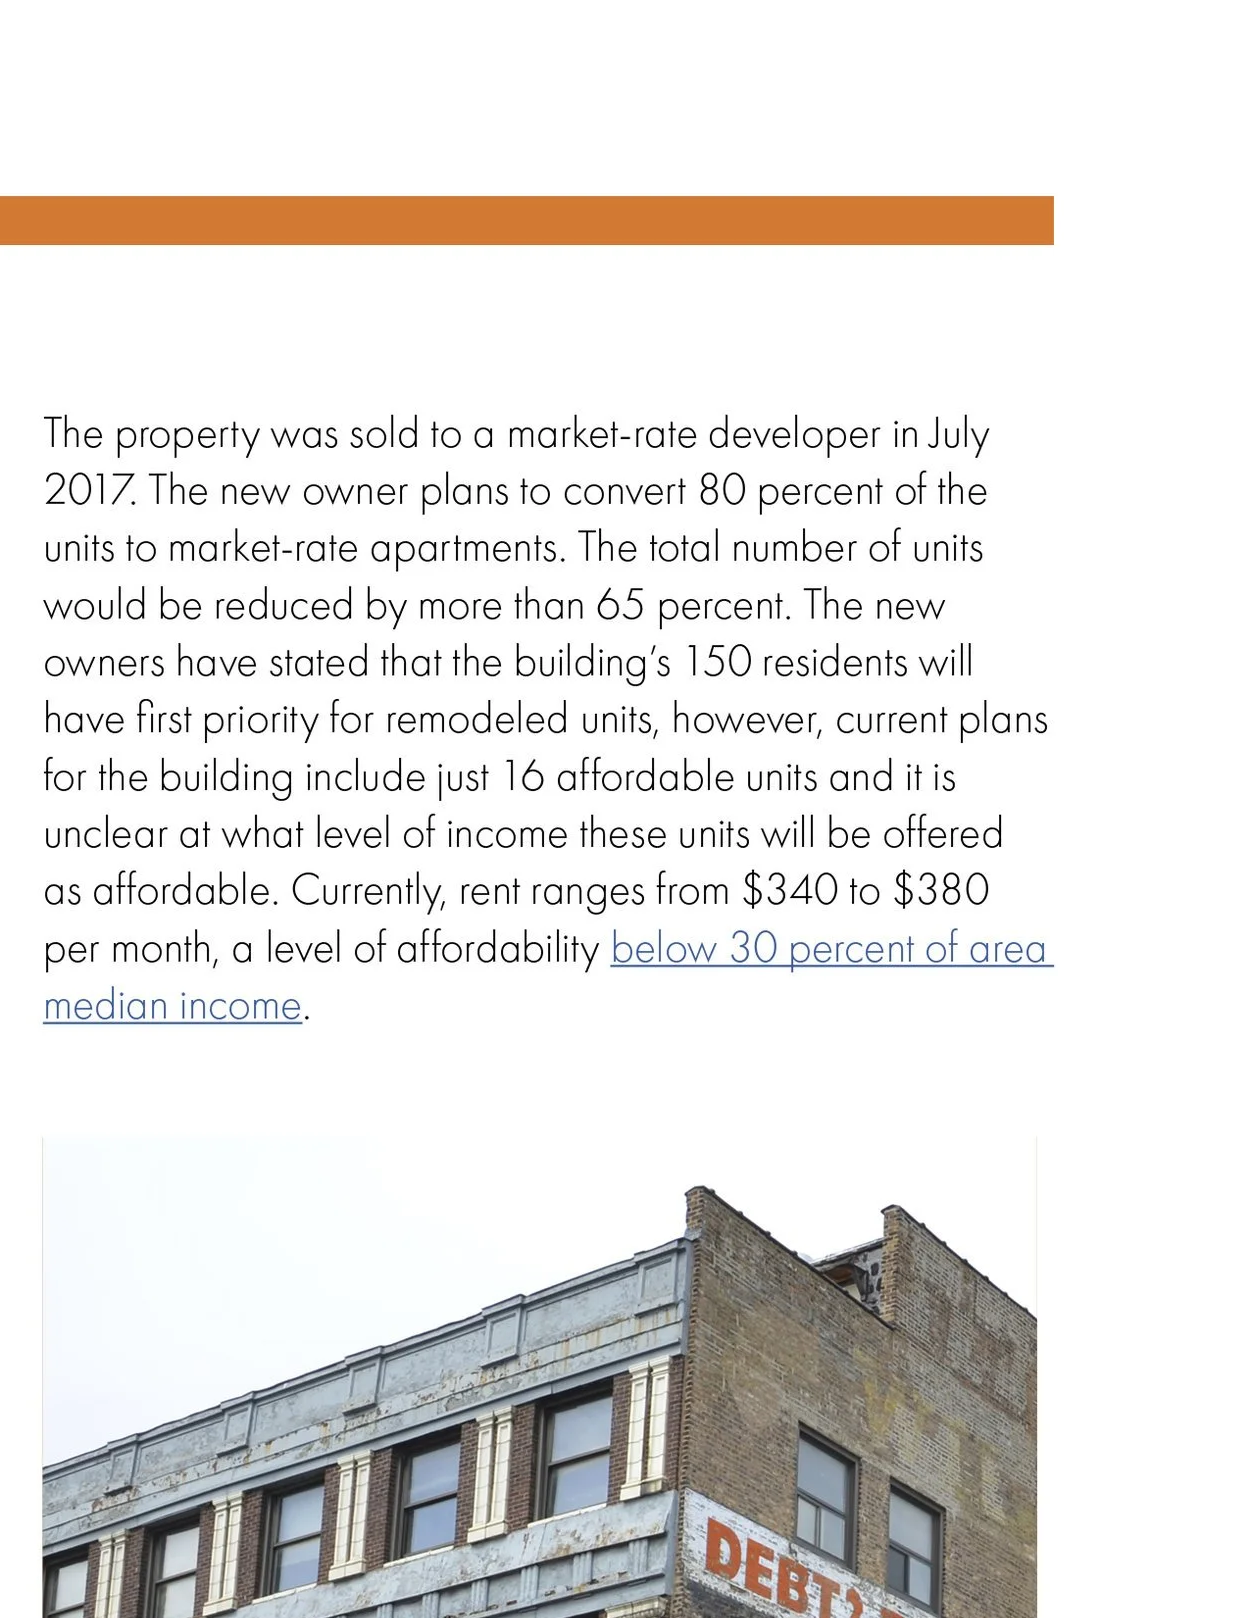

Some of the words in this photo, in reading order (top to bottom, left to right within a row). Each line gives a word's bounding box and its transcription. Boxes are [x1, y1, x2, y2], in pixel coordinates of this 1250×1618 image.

[44, 414, 102, 448] The
[117, 421, 260, 458] property
[271, 427, 337, 448] was
[350, 414, 417, 448] sold
[431, 421, 461, 448] to
[474, 427, 492, 448] a
[510, 414, 696, 448] market-rate
[710, 414, 881, 458] developer
[894, 421, 917, 447] in
[928, 414, 989, 458] July
[46, 942, 99, 973] per
[114, 929, 218, 968] month,
[233, 942, 251, 963] a
[268, 929, 340, 963] level
[355, 928, 386, 963] of
[398, 928, 599, 973] affordability
[614, 929, 717, 962] below
[731, 930, 776, 962] 30
[791, 936, 914, 973] percent
[926, 928, 958, 962] of
[971, 942, 1044, 962] area
